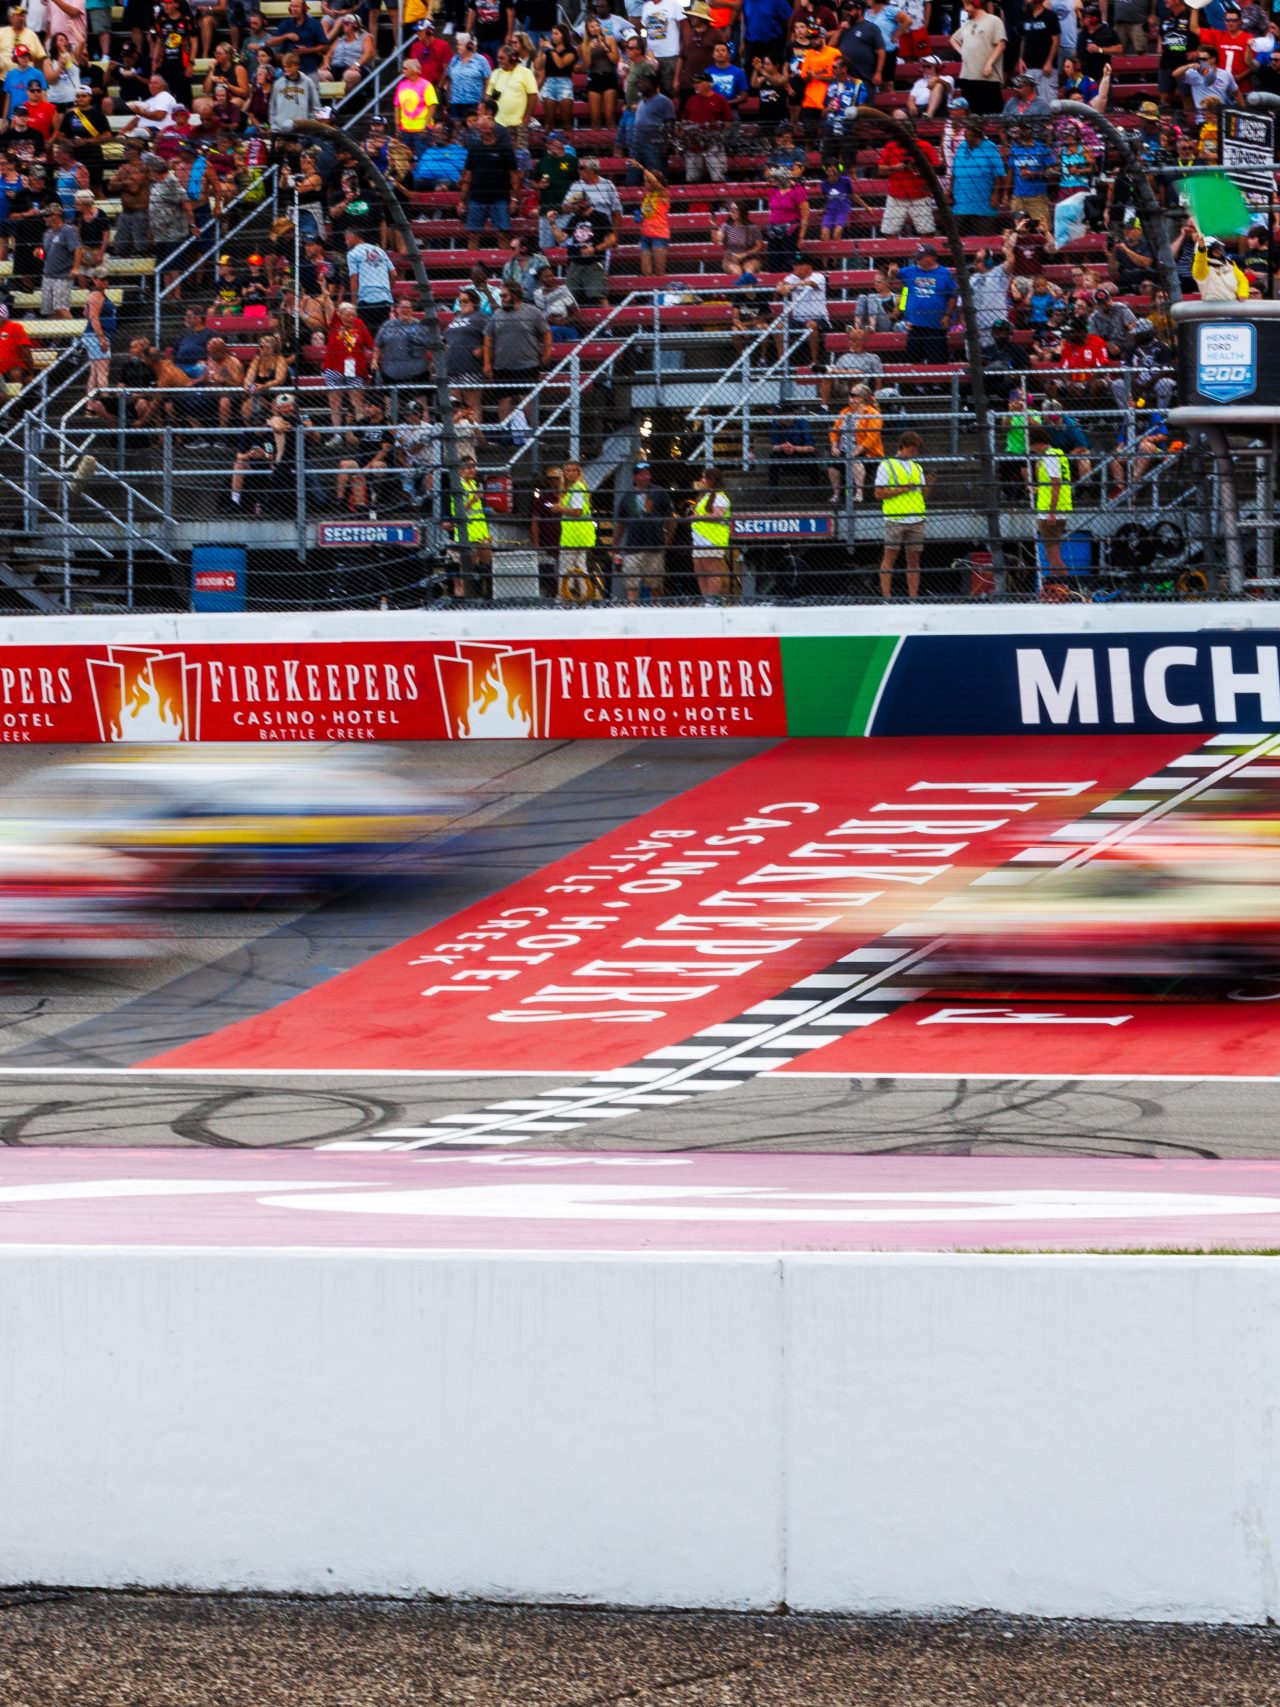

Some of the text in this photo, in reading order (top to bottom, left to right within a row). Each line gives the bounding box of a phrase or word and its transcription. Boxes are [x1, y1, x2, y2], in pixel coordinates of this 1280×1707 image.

[1206, 343, 1232, 351] FORD
[1201, 366, 1247, 382] 200
[734, 518, 817, 533] SECTION 1
[323, 527, 404, 541] SECTION 1
[207, 659, 419, 703] FIREKEEPERS
[557, 656, 774, 699] FIREKEEPERS
[3, 713, 55, 727] OTEL
[233, 709, 400, 726] CASINO HOTEL
[583, 706, 754, 722] CASINO HOTEL
[259, 728, 376, 740] BATTLE CREEK
[610, 725, 729, 737] BATTLE CREEK
[408, 829, 697, 966] BATTLE CREEK
[421, 801, 820, 997] CASINO HOTEL
